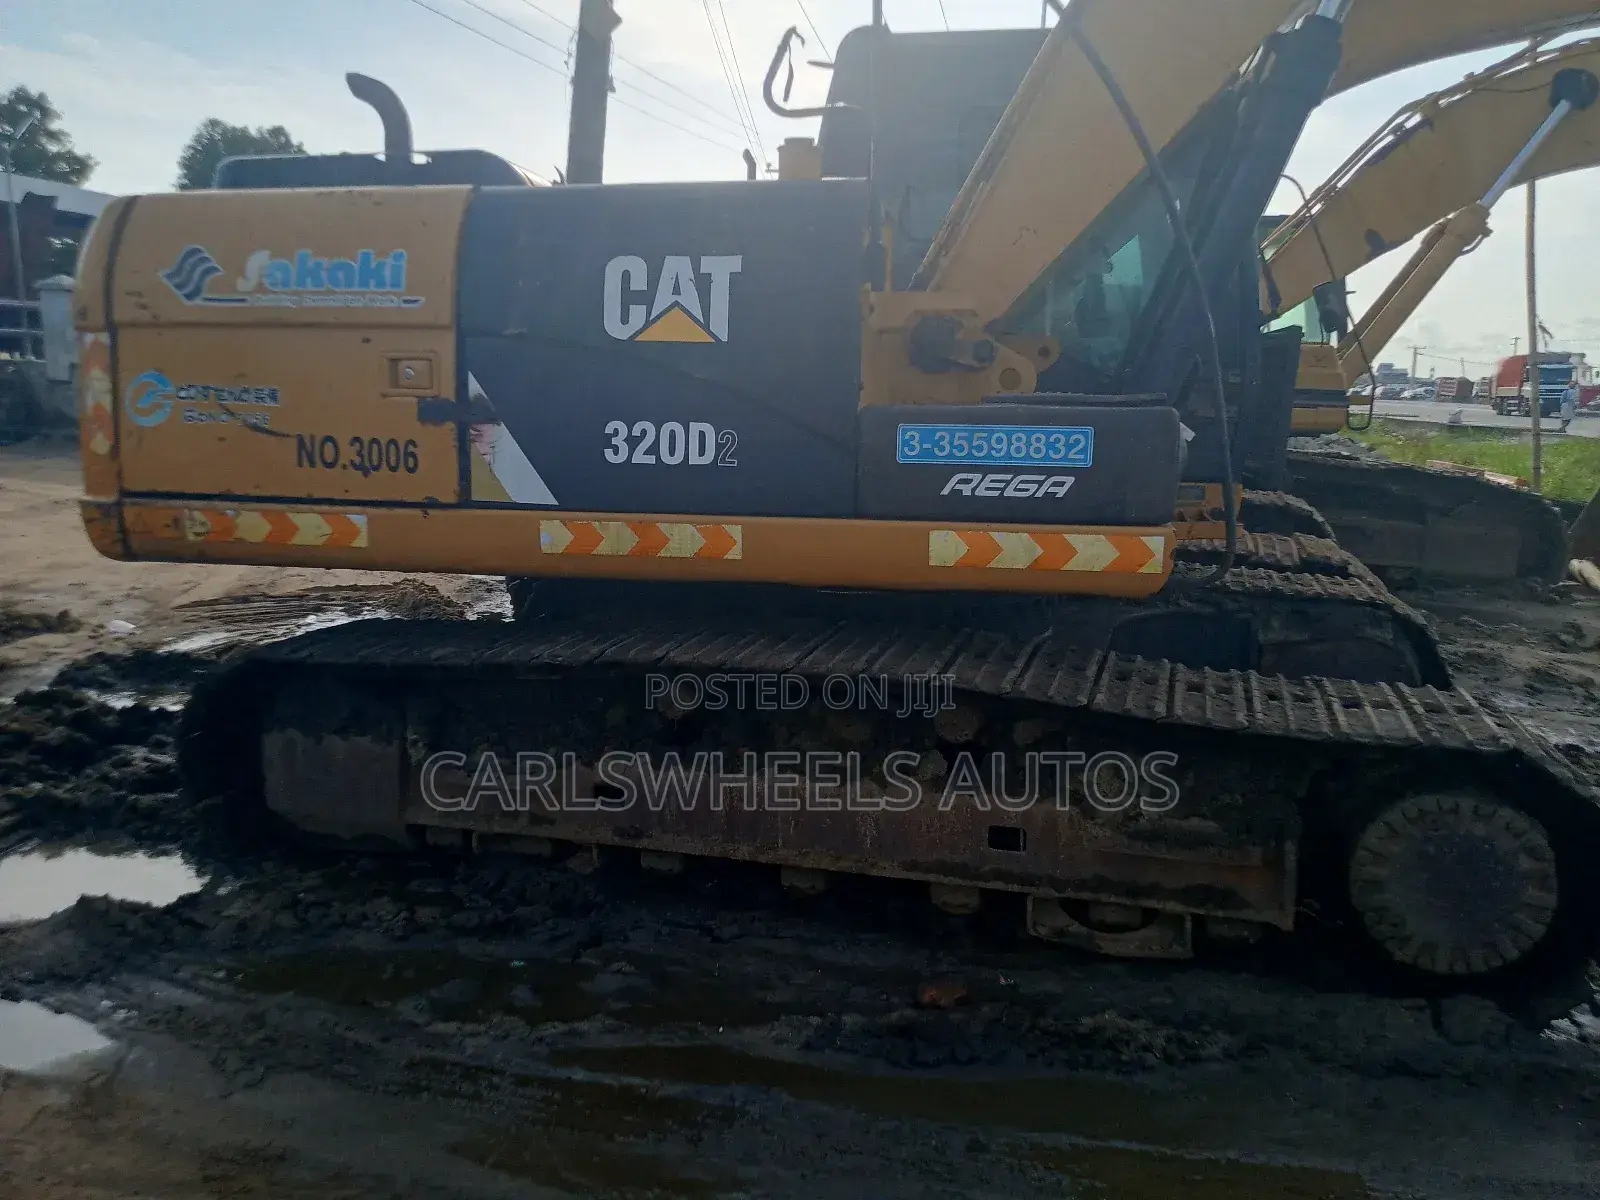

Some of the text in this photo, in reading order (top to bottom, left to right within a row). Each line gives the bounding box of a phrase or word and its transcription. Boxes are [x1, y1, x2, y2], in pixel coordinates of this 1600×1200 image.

[604, 255, 742, 342] CAT
[604, 420, 738, 466] 320D2
[903, 430, 1086, 460] 3-35598832
[940, 473, 1075, 498] REGA
